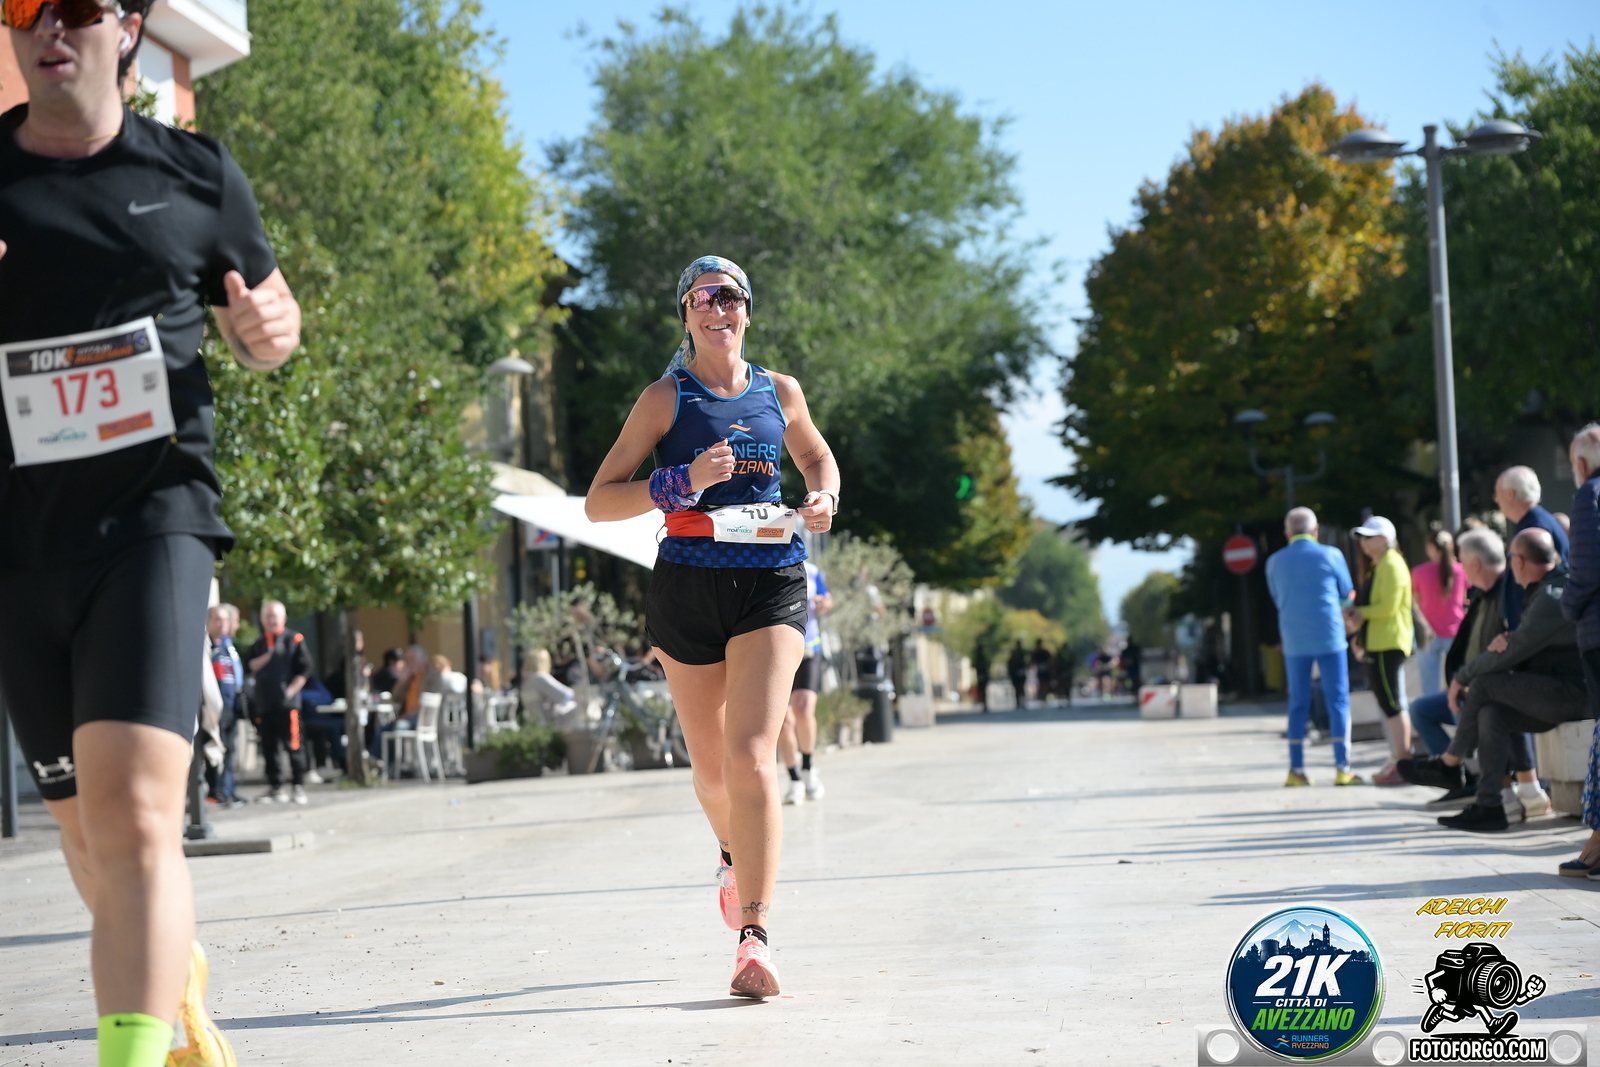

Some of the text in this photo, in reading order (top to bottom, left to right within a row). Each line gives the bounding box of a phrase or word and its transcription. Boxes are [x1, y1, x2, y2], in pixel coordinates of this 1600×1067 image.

[29, 348, 69, 372] 10K
[52, 368, 119, 416] 173
[694, 443, 776, 461] RNERS
